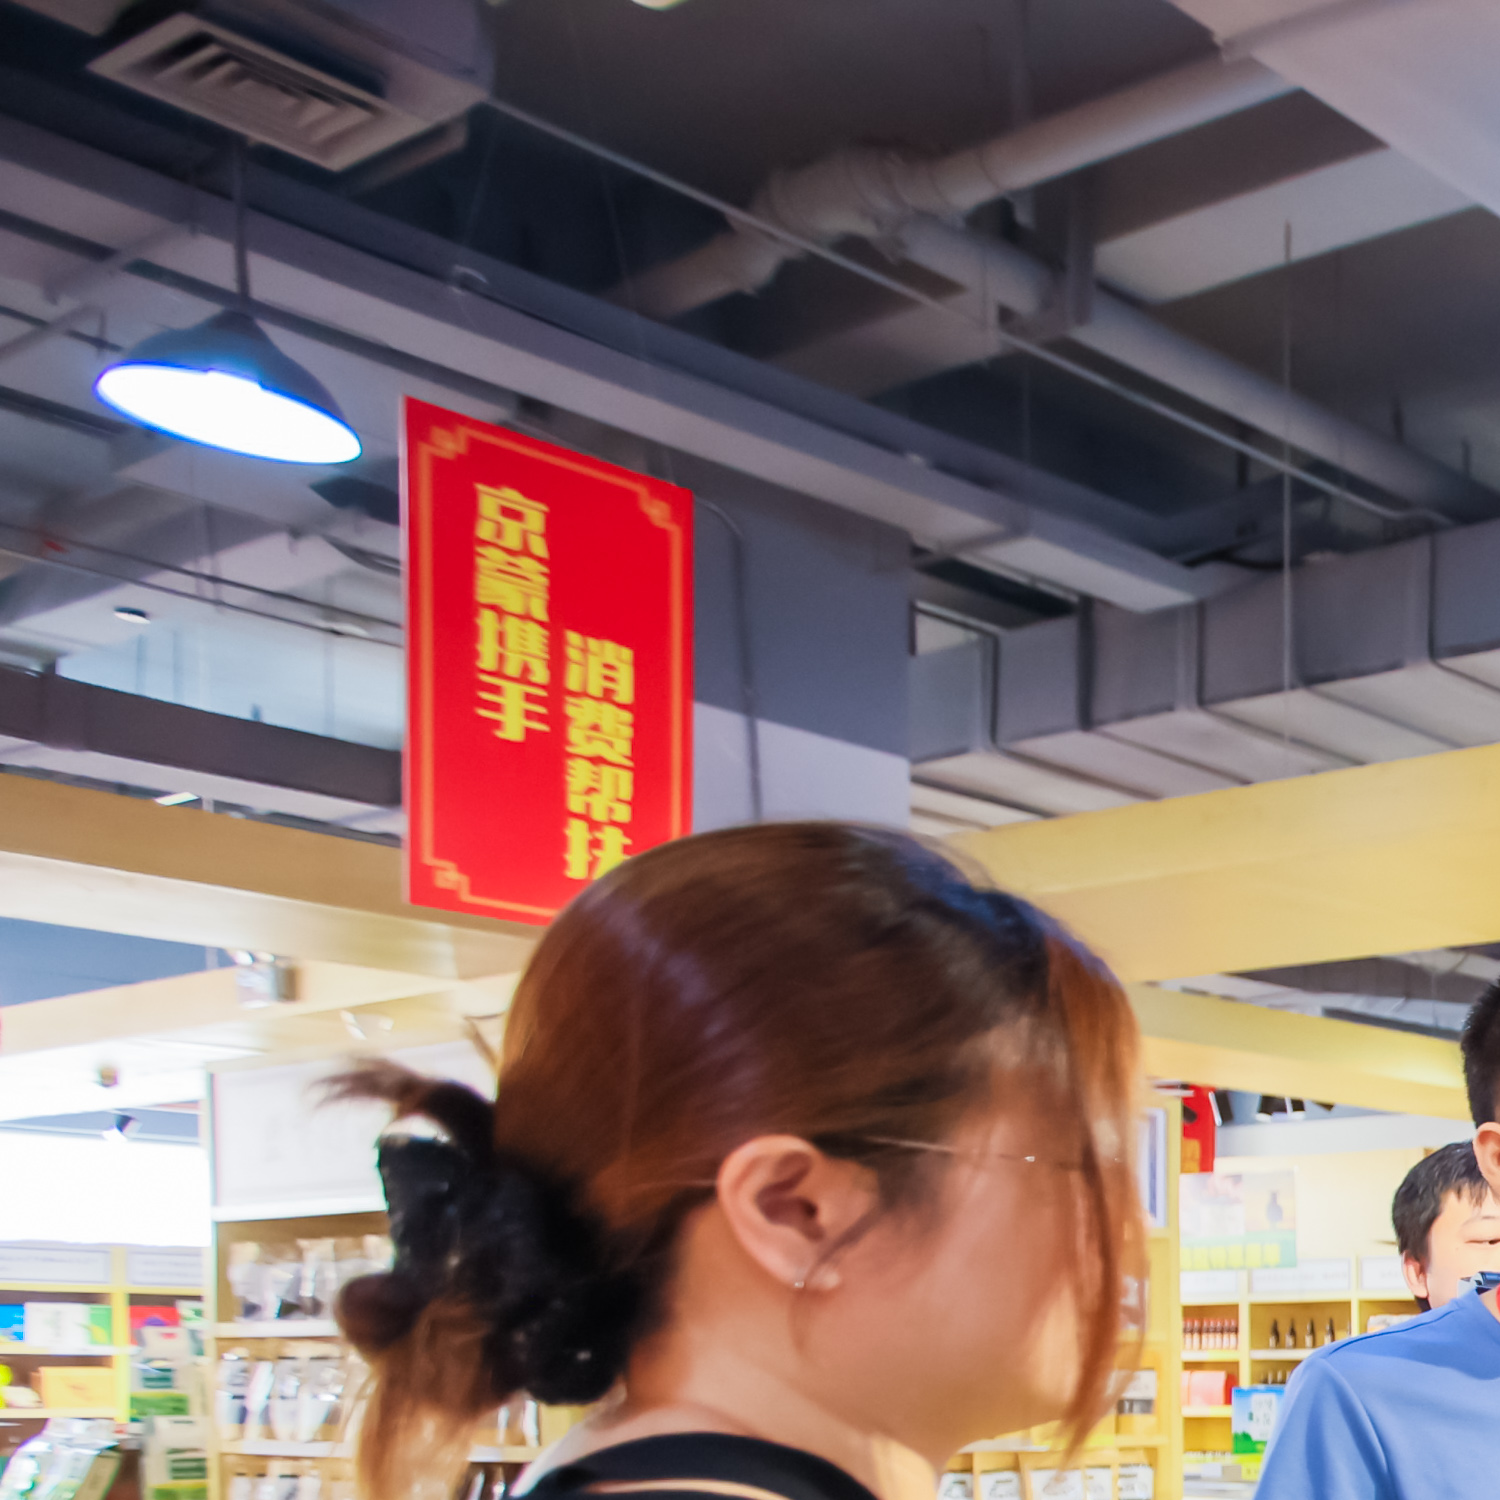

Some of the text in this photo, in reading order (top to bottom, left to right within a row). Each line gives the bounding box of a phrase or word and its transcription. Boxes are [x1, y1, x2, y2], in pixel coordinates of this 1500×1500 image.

[474, 484, 550, 742] 京蒙携手
[562, 630, 636, 883] 消费帮扶
